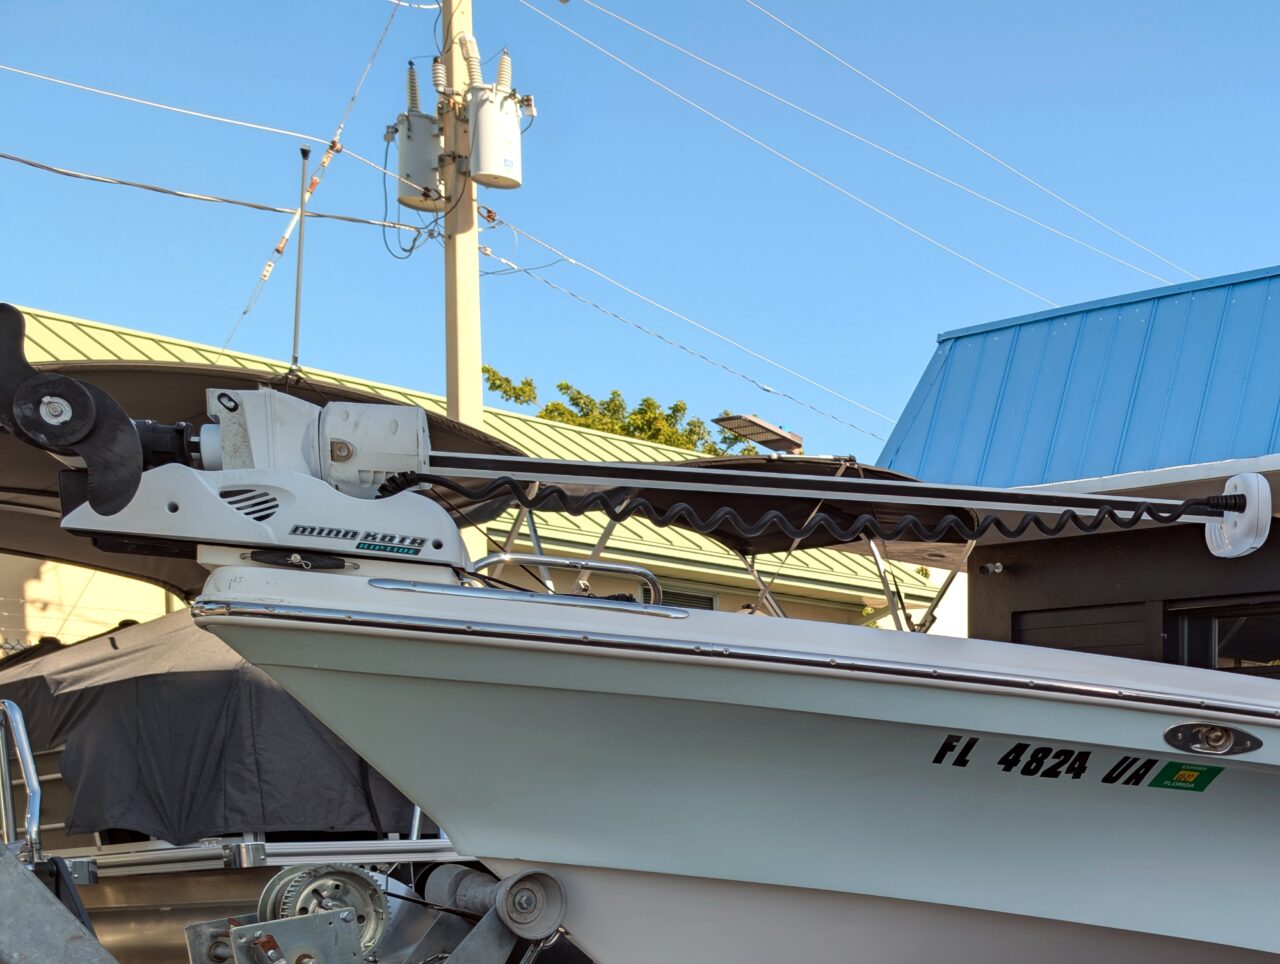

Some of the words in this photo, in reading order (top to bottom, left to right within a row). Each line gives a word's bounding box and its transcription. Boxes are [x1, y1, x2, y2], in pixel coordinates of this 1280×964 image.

[932, 734, 980, 768] FL
[997, 742, 1092, 780] 4824
[1101, 756, 1160, 787] UA
